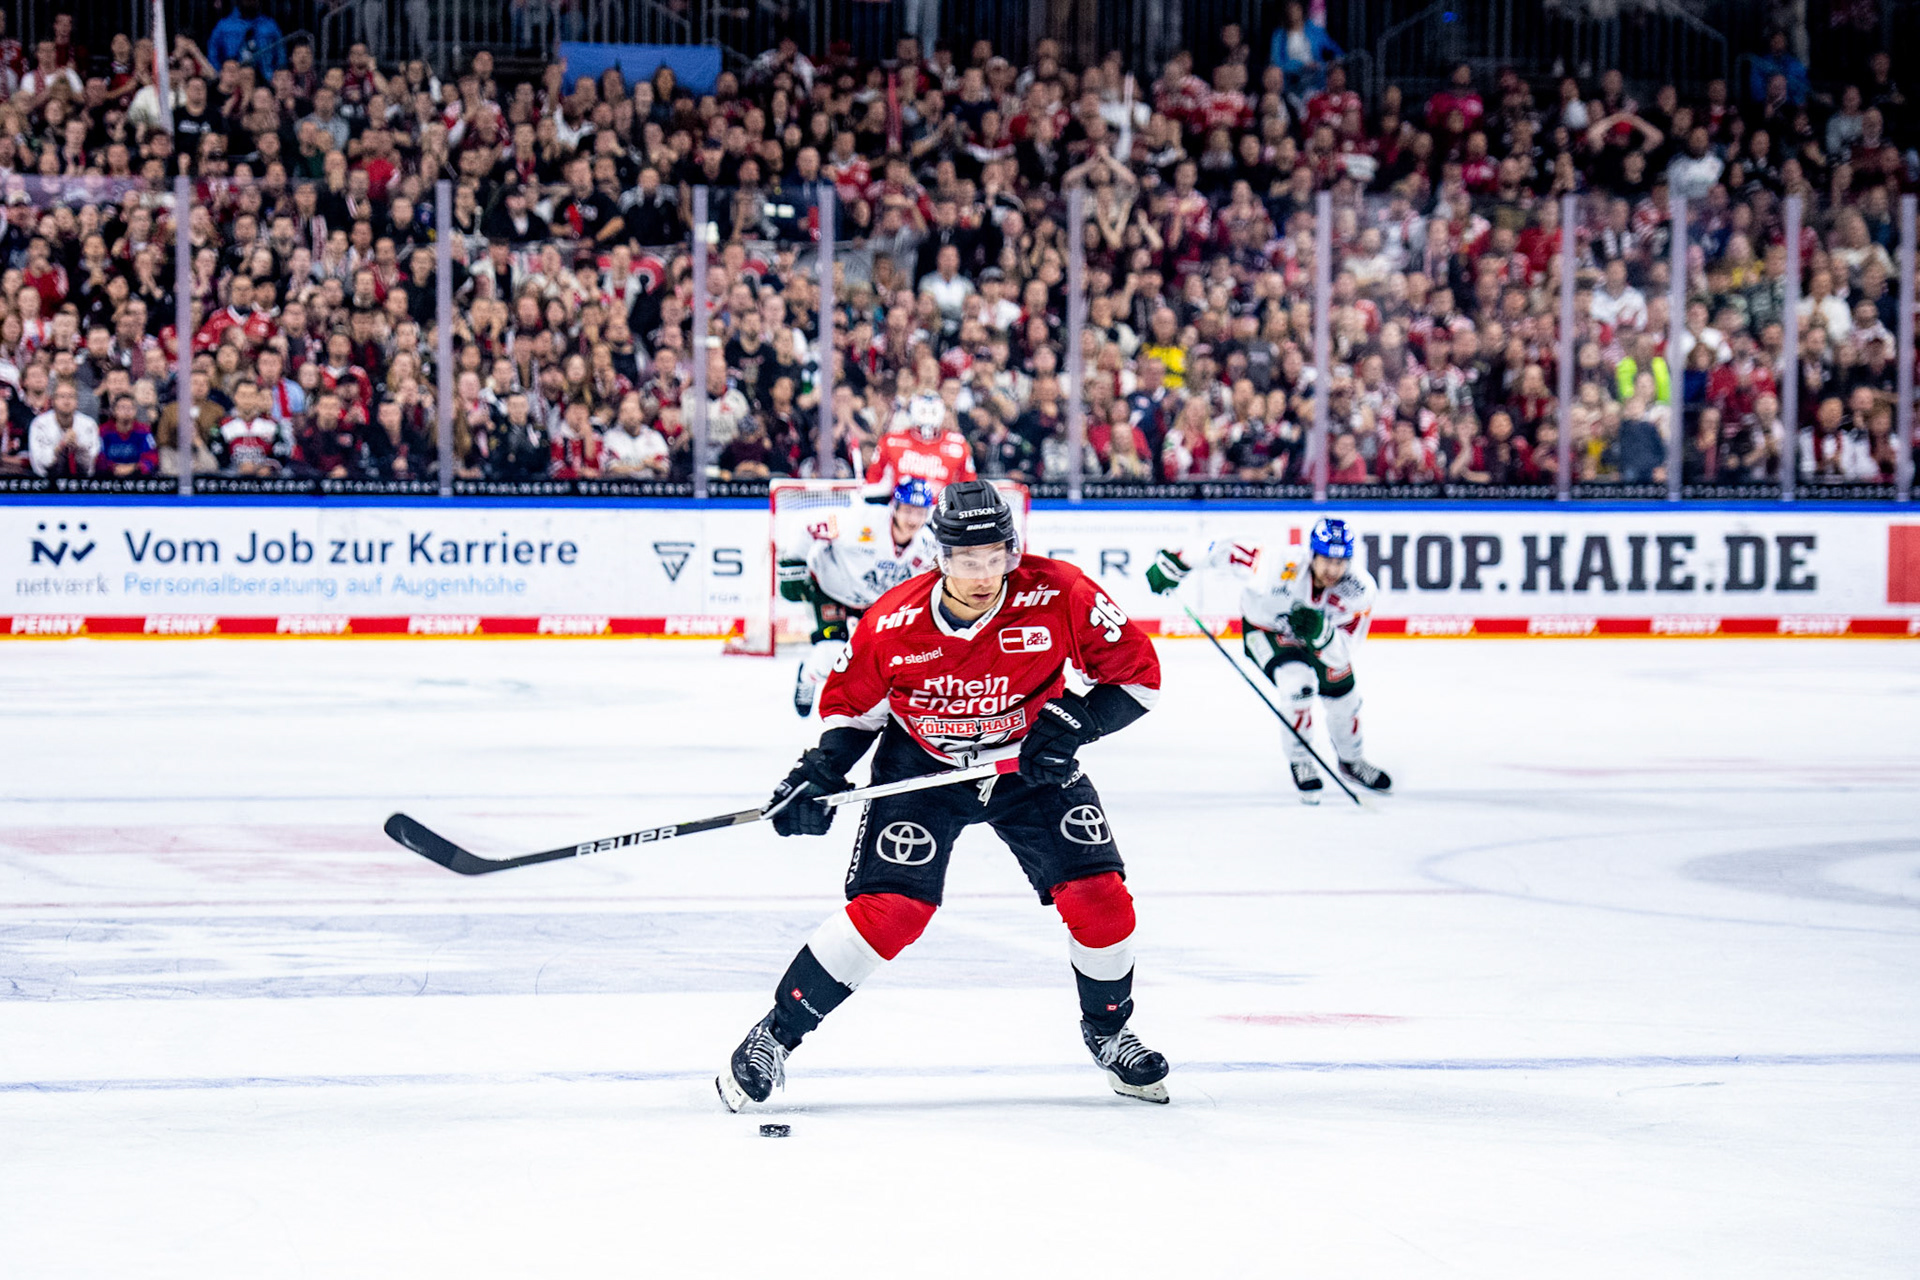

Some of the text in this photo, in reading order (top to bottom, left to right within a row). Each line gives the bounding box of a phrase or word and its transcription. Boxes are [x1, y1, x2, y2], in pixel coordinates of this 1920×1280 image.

[958, 507, 996, 519] STETSON
[966, 522, 996, 531] BAUER
[123, 530, 579, 564] Vom Job zur Karriere
[1362, 534, 1817, 592] HOP.HAIE.DE
[123, 572, 528, 599] Personalberatung auf Augenhöhe
[1012, 585, 1061, 608] HIT
[875, 604, 924, 633] HIT
[1089, 591, 1128, 643] 36
[905, 647, 944, 665] steinel
[924, 674, 1009, 697] Rhein
[914, 711, 1022, 736] KÖLNER HAIE
[576, 826, 678, 858] BAUER
[846, 815, 867, 885] TOYOTA
